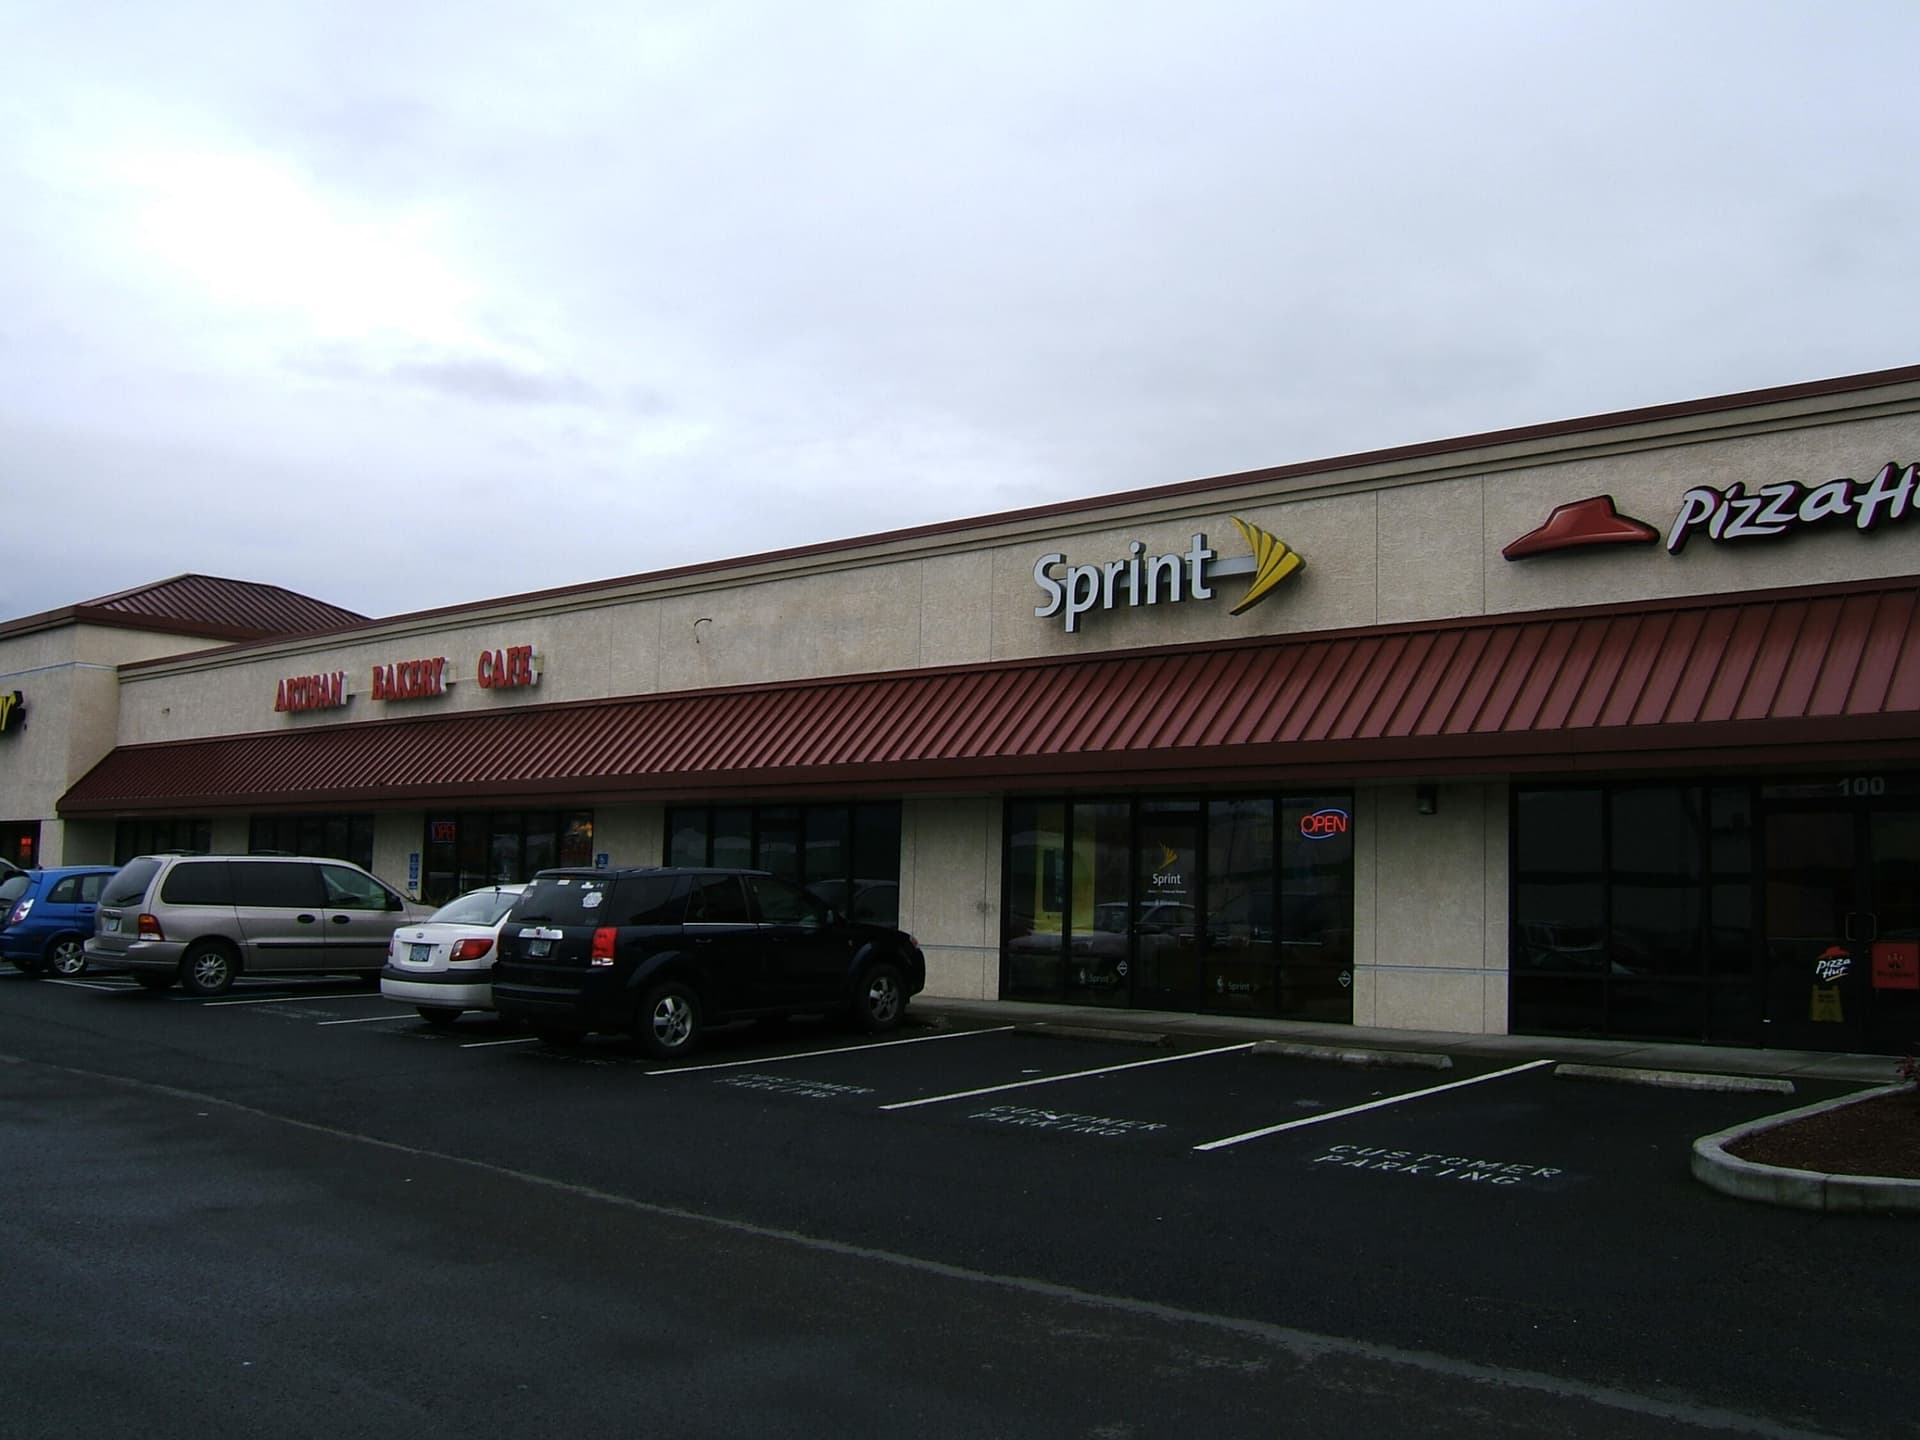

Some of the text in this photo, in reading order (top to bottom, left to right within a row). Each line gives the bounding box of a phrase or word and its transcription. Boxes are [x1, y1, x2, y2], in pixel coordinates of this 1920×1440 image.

[1033, 532, 1216, 632] Sprint
[275, 645, 533, 712] ARTISAN BAKERY CAFE
[1838, 776, 1886, 797] 100
[1300, 815, 1348, 834] OPEN
[1152, 873, 1182, 886] Sprint
[1822, 966, 1849, 980] Hut
[968, 1112, 1127, 1137] PARKING
[990, 1105, 1168, 1131] CUSTOMER
[1313, 1154, 1521, 1185] PARKING
[1329, 1144, 1563, 1178] CUSTOMER
